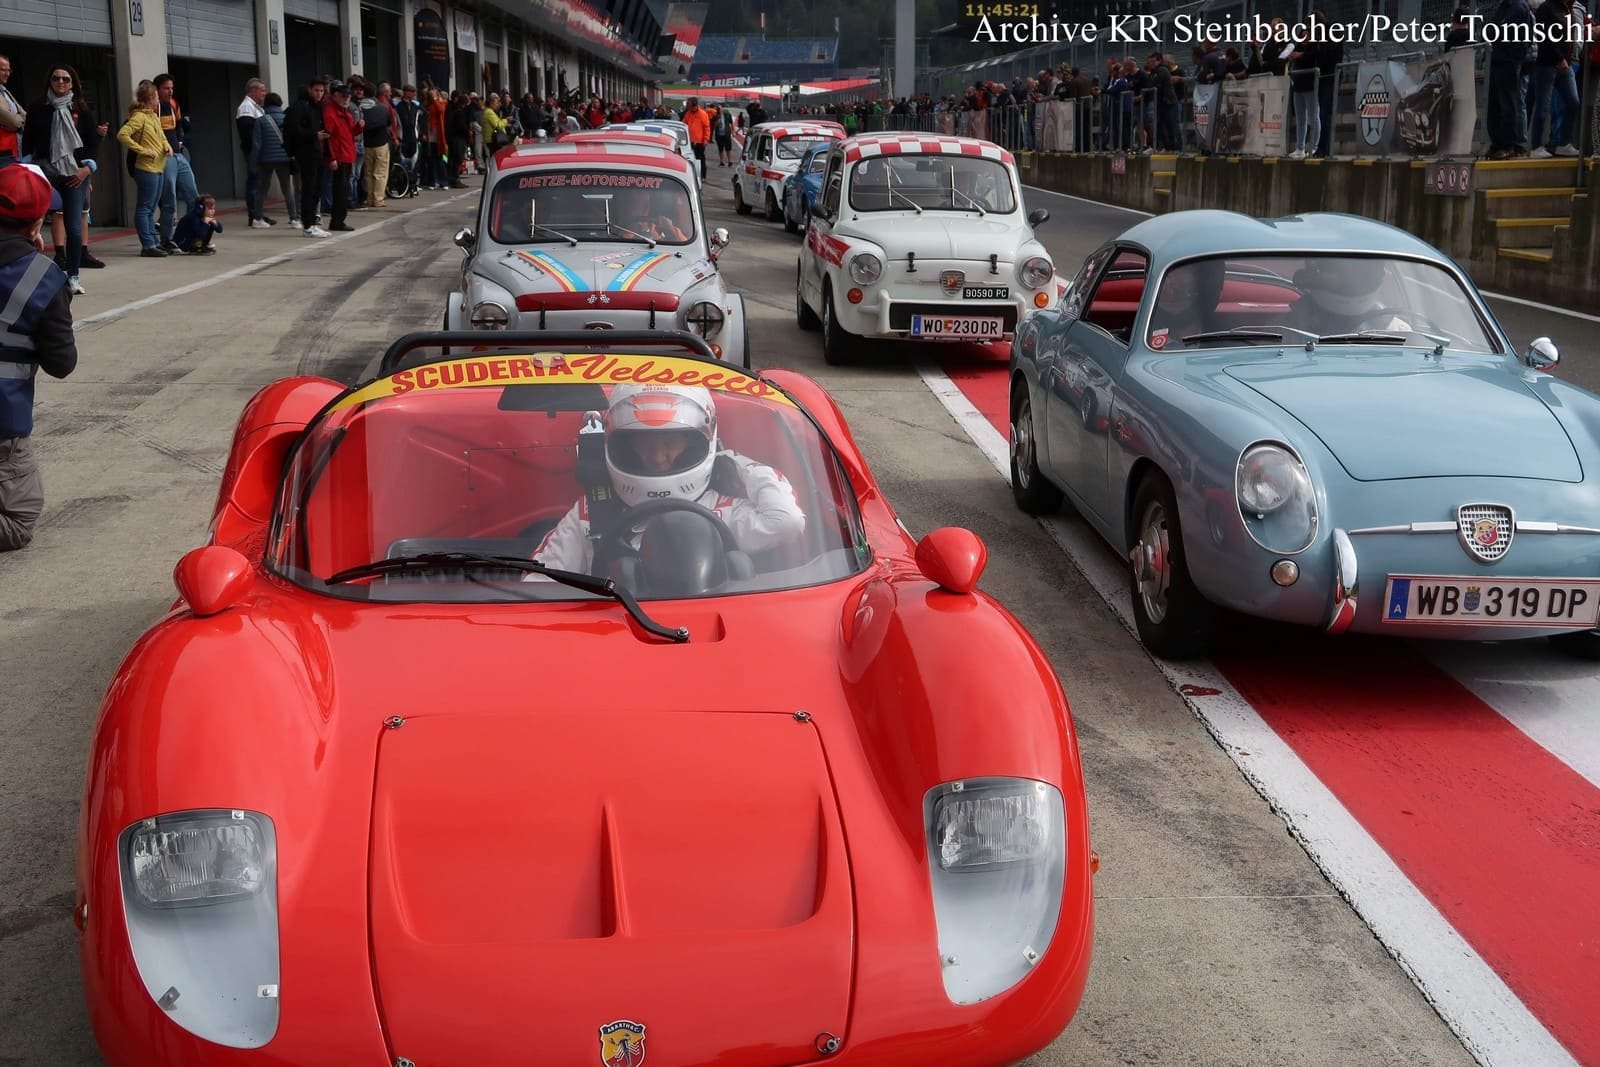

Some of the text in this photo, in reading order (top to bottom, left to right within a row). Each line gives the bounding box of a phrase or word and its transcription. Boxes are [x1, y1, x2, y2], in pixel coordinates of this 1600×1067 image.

[132, 2, 143, 23] 29
[966, 3, 1040, 17] 11:45:21
[518, 174, 663, 189] DIETZE-MOTORSPORT
[965, 288, 1007, 298] 90590 PC
[923, 319, 943, 333] WO
[953, 319, 979, 334] 230
[981, 320, 998, 335] DR
[391, 353, 775, 397] SCUDERIA Velsecco
[1393, 585, 1587, 618] A WB 319 DP
